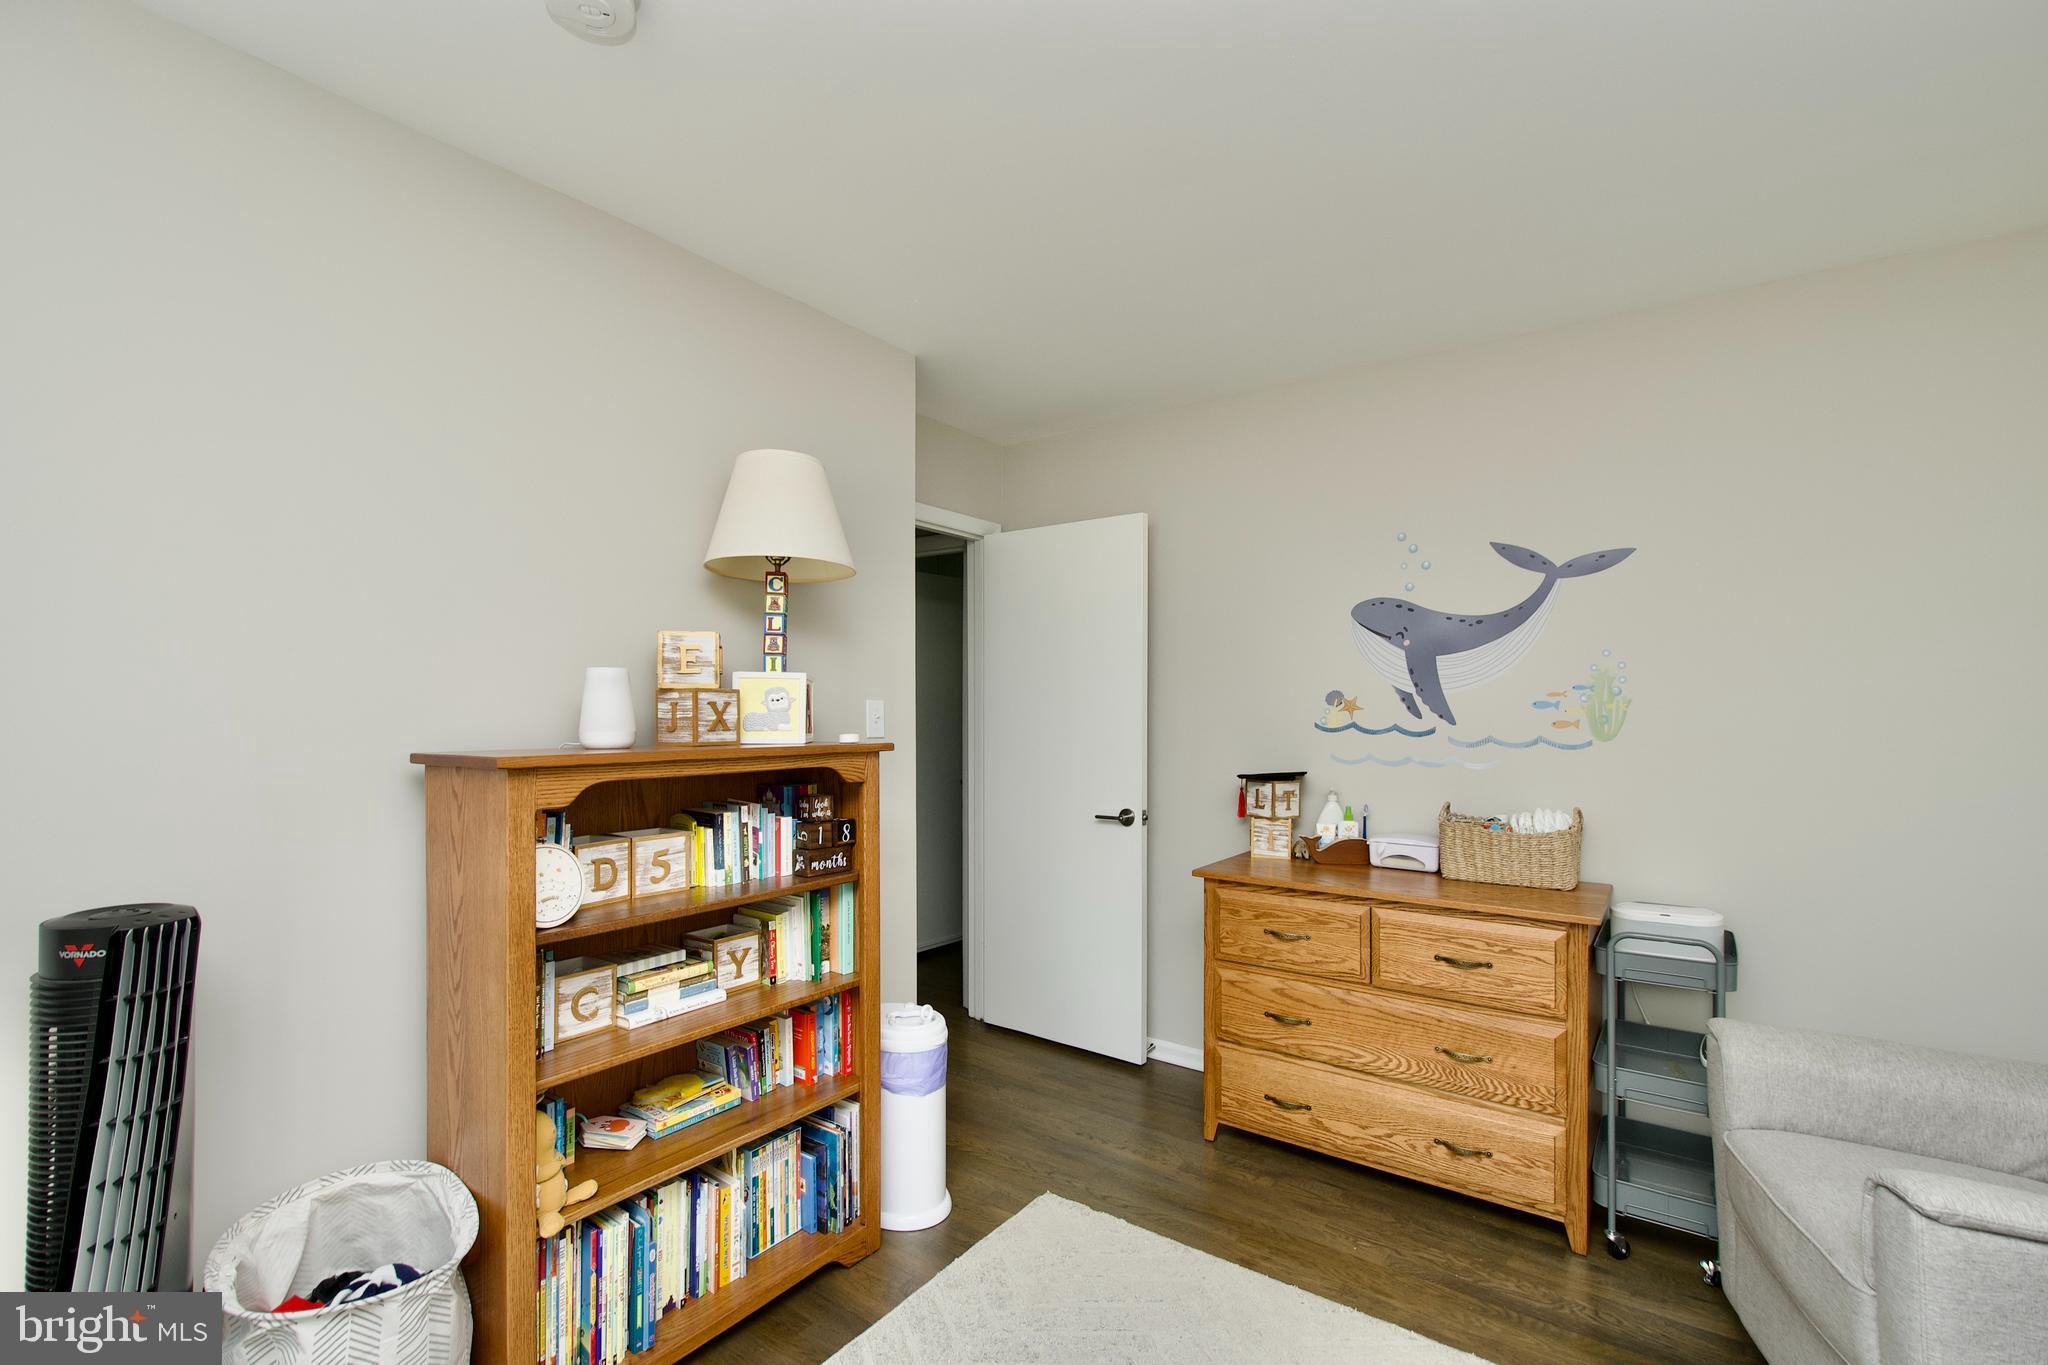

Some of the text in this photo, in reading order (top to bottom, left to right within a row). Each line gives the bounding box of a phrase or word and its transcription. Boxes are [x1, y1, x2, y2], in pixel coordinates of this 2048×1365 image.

[678, 644, 702, 674] E
[707, 701, 732, 732] X
[591, 858, 618, 892] D
[650, 849, 671, 885] 5
[811, 852, 847, 871] months
[58, 948, 107, 960] VORNADO
[726, 948, 752, 980] Y
[571, 986, 599, 1022] C
